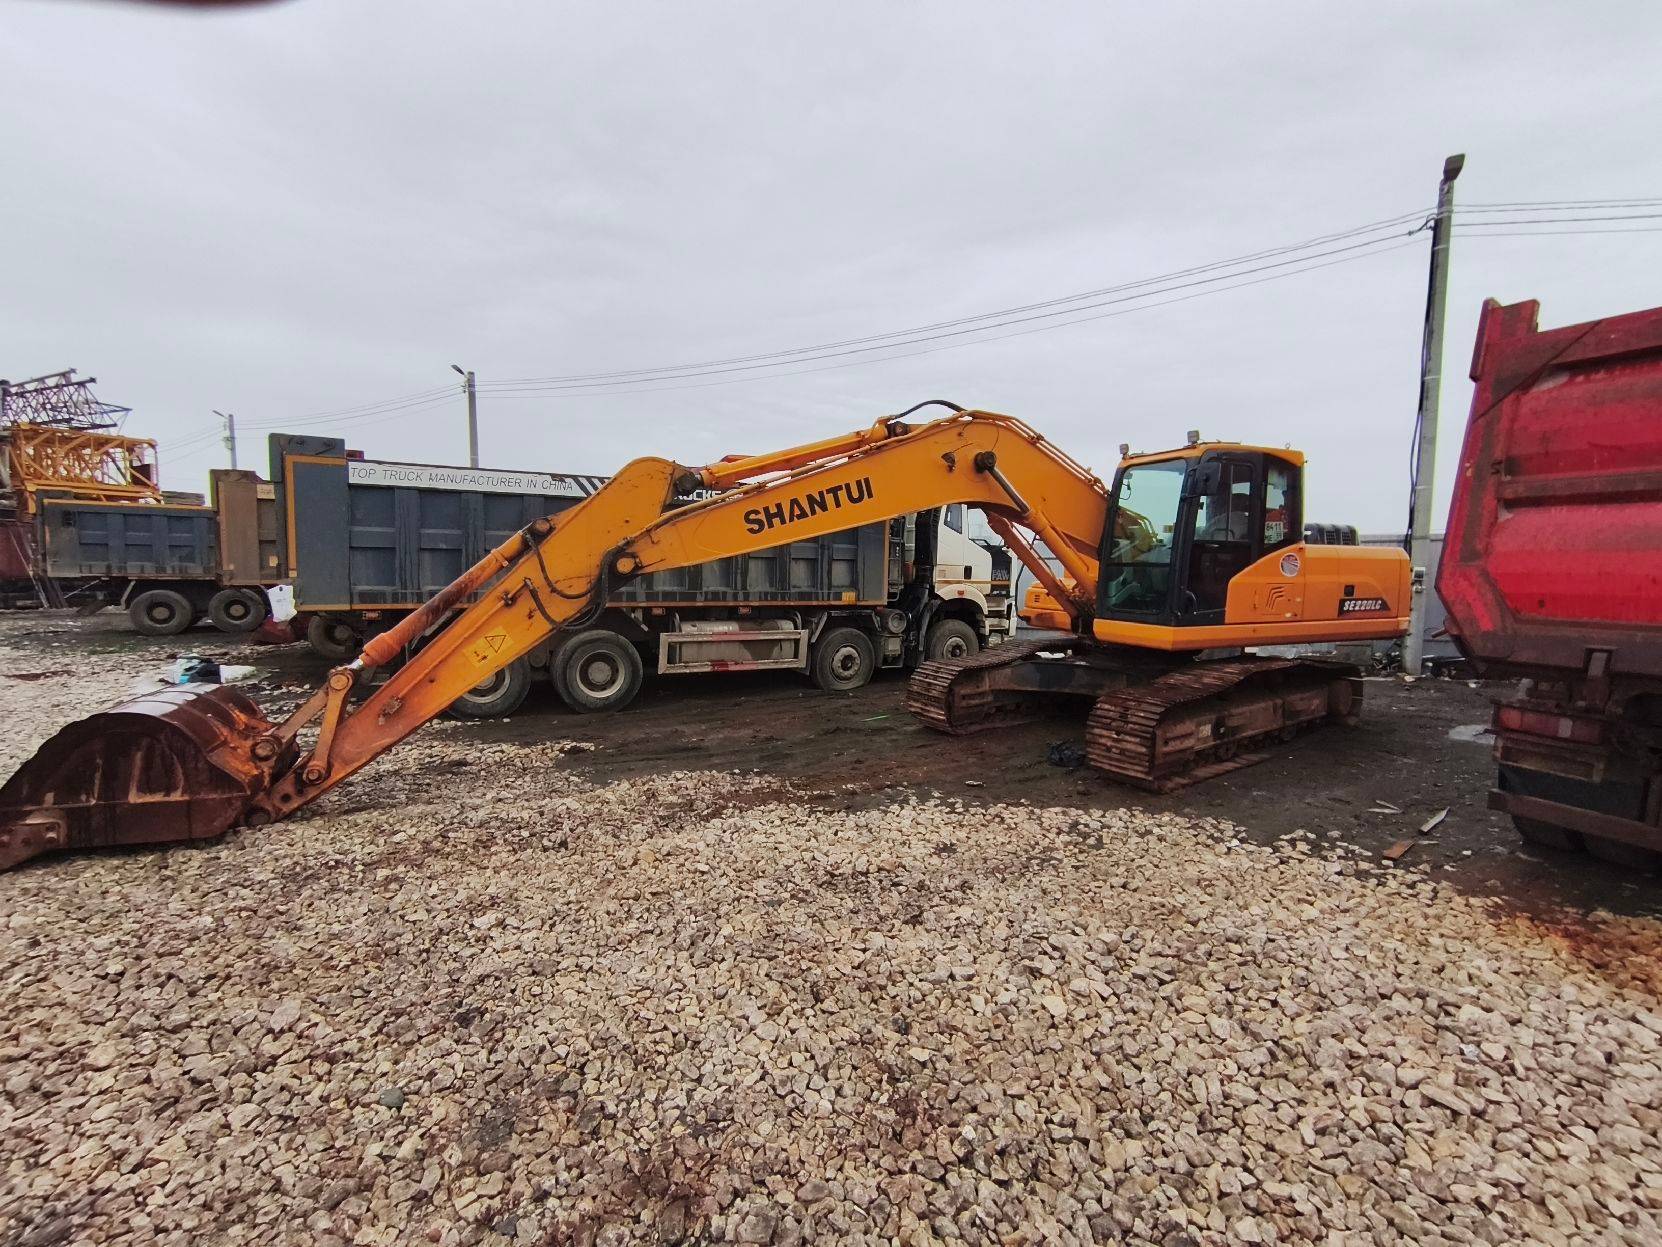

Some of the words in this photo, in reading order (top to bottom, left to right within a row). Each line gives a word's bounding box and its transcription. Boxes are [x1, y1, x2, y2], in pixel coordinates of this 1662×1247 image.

[351, 467, 377, 479] TOP
[382, 469, 424, 482] TRUCK
[428, 472, 522, 488] MANUFACTURER
[526, 479, 537, 489] IN
[541, 479, 573, 491] CHINA
[743, 476, 874, 535] SHANTUI
[992, 569, 1010, 580] FAW
[1343, 600, 1382, 611] SE220LC
